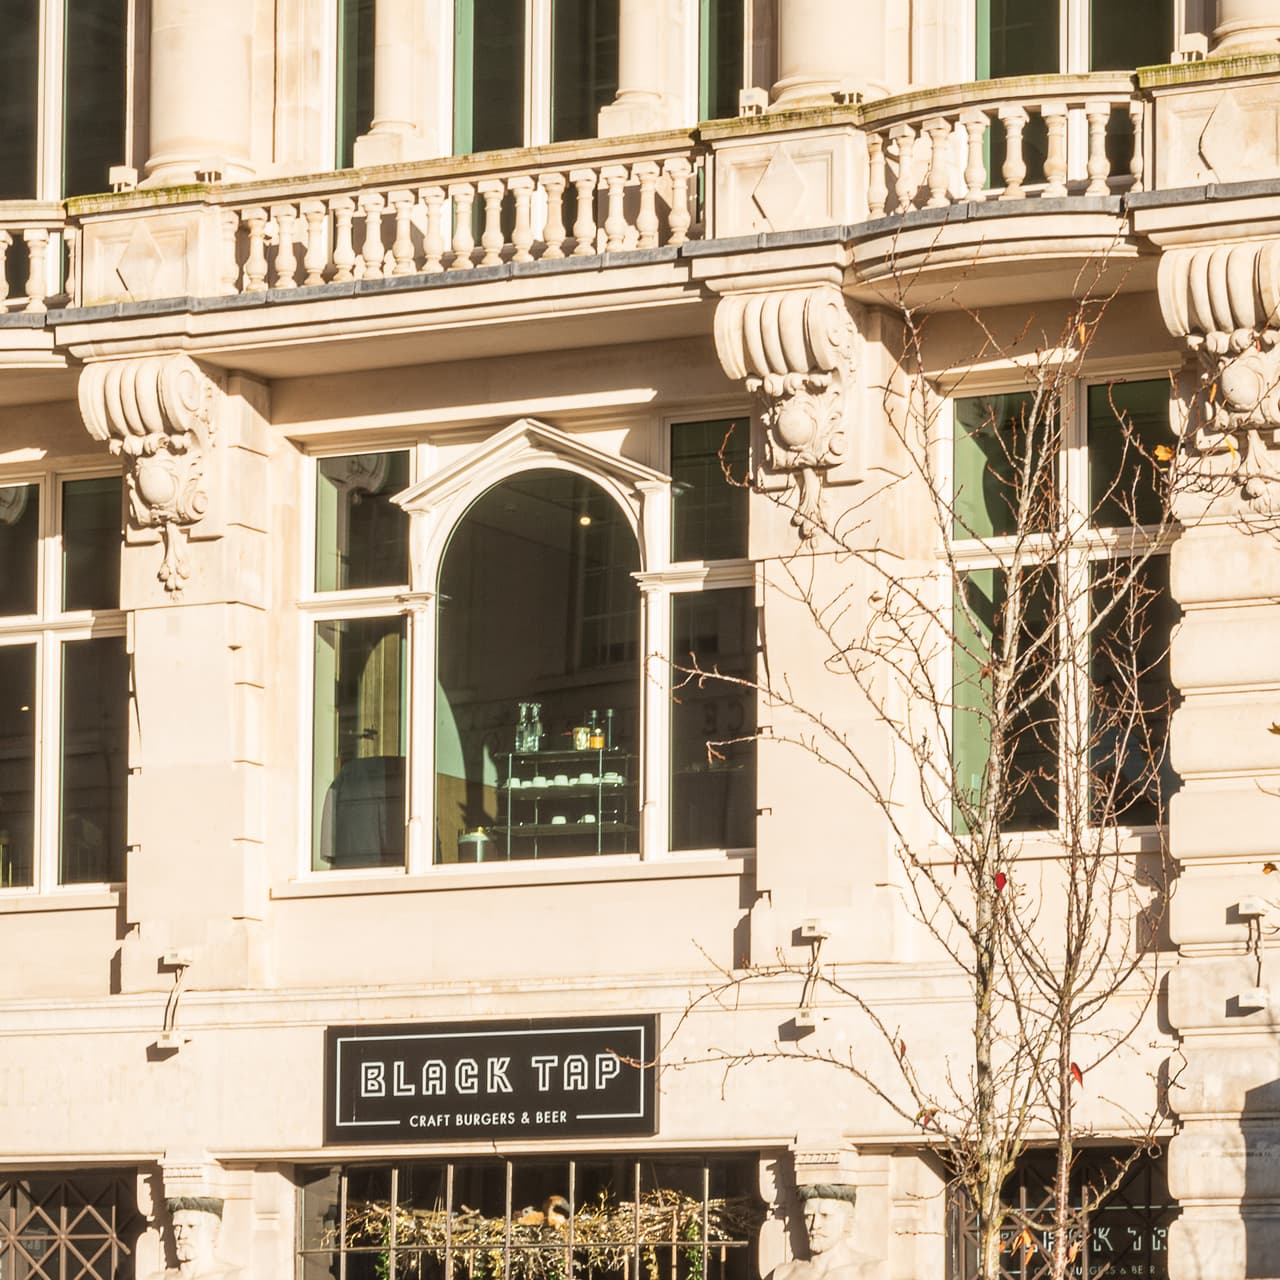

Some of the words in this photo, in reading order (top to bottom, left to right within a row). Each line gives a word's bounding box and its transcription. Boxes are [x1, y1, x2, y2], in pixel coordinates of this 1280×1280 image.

[361, 1057, 513, 1098] BLACK
[531, 1054, 620, 1092] TAP
[409, 1113, 450, 1128] CRAFT
[455, 1112, 516, 1126] BURGERS
[521, 1111, 530, 1124] &
[536, 1110, 568, 1124] BEER
